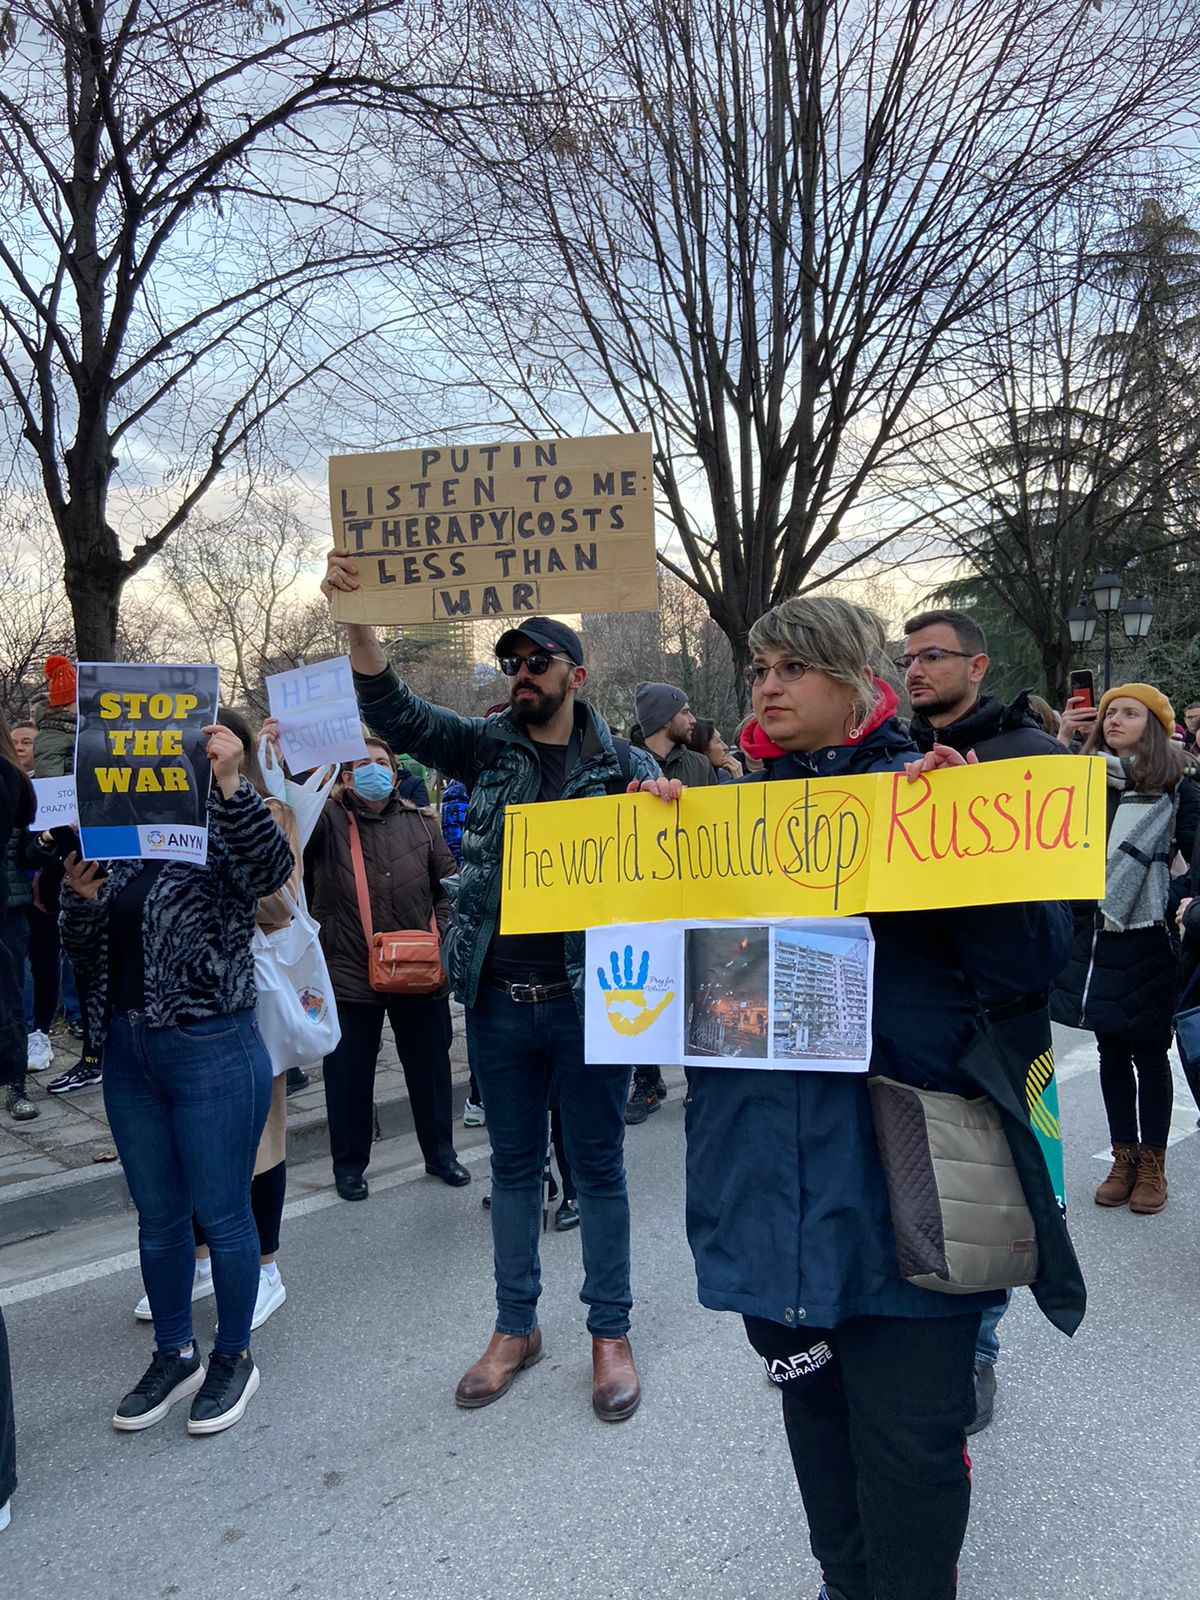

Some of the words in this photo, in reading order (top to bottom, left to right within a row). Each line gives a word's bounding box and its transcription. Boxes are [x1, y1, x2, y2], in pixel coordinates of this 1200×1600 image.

[421, 443, 557, 478] PUTIN
[341, 475, 495, 518] LISTEN
[526, 475, 573, 503] TO
[593, 470, 648, 497] ME:
[347, 510, 510, 550] THERAPY
[517, 504, 625, 539] COSTS
[378, 551, 466, 585] LESS
[495, 543, 598, 578] THAN
[439, 583, 536, 616] WAR
[282, 667, 344, 710] НЕТ
[100, 693, 198, 720] STOP
[108, 730, 184, 756] THE
[94, 767, 190, 793] WAR
[40, 803, 67, 814] CRAZY
[168, 833, 203, 849] ANYN
[504, 811, 553, 891] The
[560, 802, 645, 886] world
[651, 784, 774, 881] should
[783, 780, 860, 911] stop
[887, 757, 1093, 864] Russia!
[761, 1340, 829, 1374] ARS
